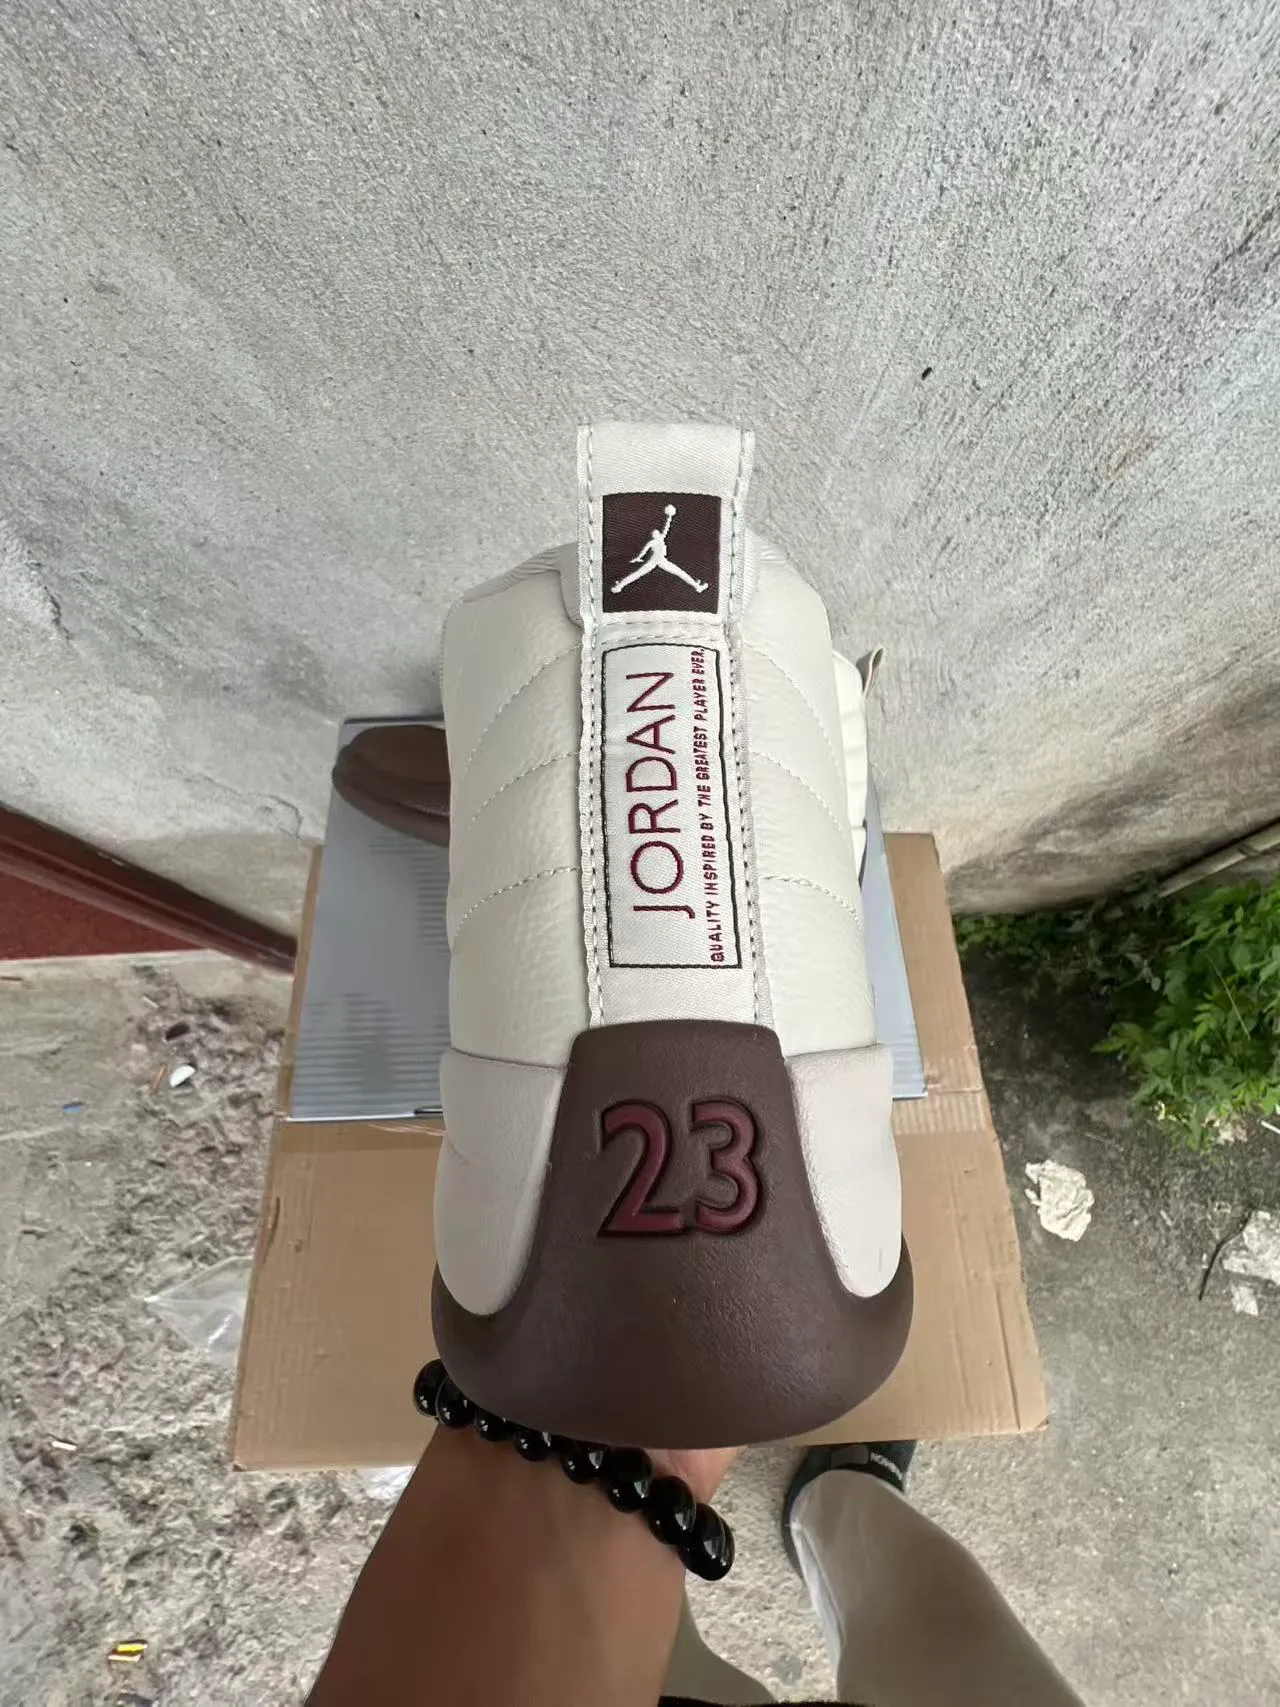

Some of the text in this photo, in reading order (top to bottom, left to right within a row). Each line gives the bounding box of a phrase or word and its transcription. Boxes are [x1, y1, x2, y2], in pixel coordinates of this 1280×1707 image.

[693, 678, 708, 721] PLAYER
[693, 726, 710, 780] GREATEST
[626, 672, 695, 919] JORDAN
[697, 785, 711, 806] THE
[699, 813, 714, 830] BY
[701, 834, 718, 895] INSPIRED
[706, 902, 725, 962] QUALITY
[599, 1099, 761, 1236] 23
